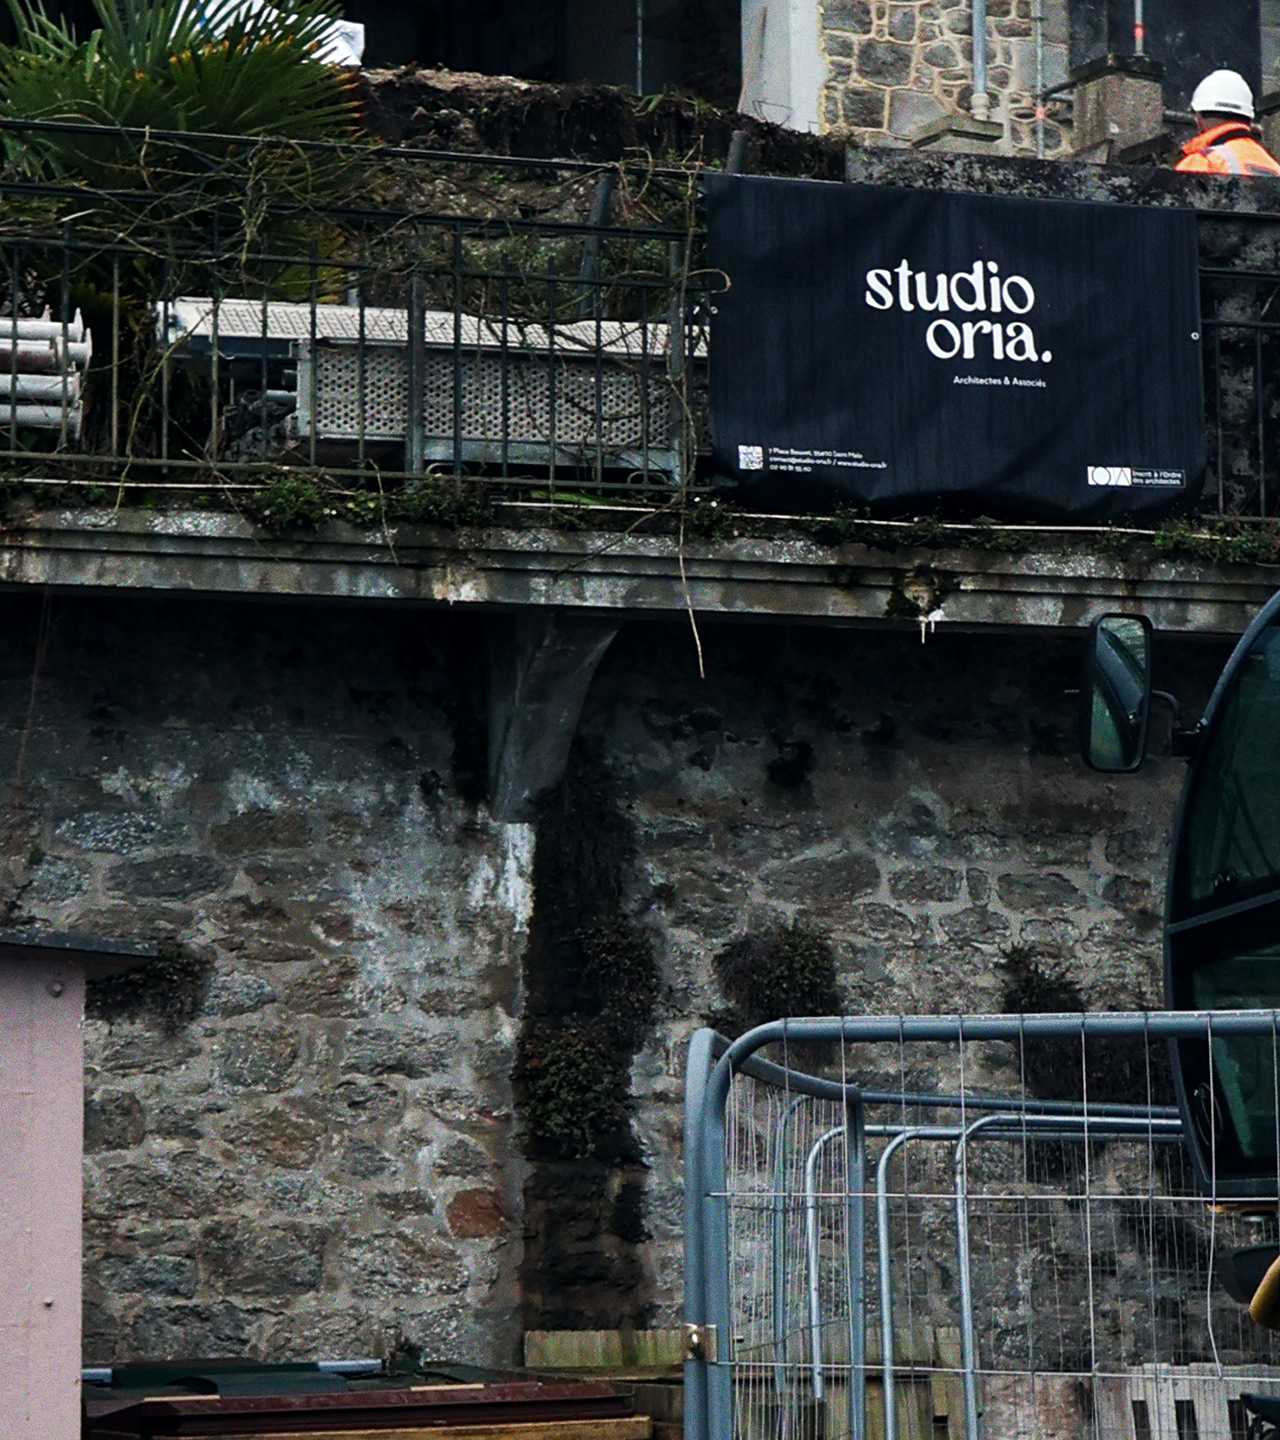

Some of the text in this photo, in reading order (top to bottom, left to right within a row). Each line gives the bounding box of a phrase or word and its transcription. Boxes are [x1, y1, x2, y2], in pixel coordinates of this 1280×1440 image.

[865, 258, 1035, 314] studio
[953, 375, 1047, 388] Architectes & Associés
